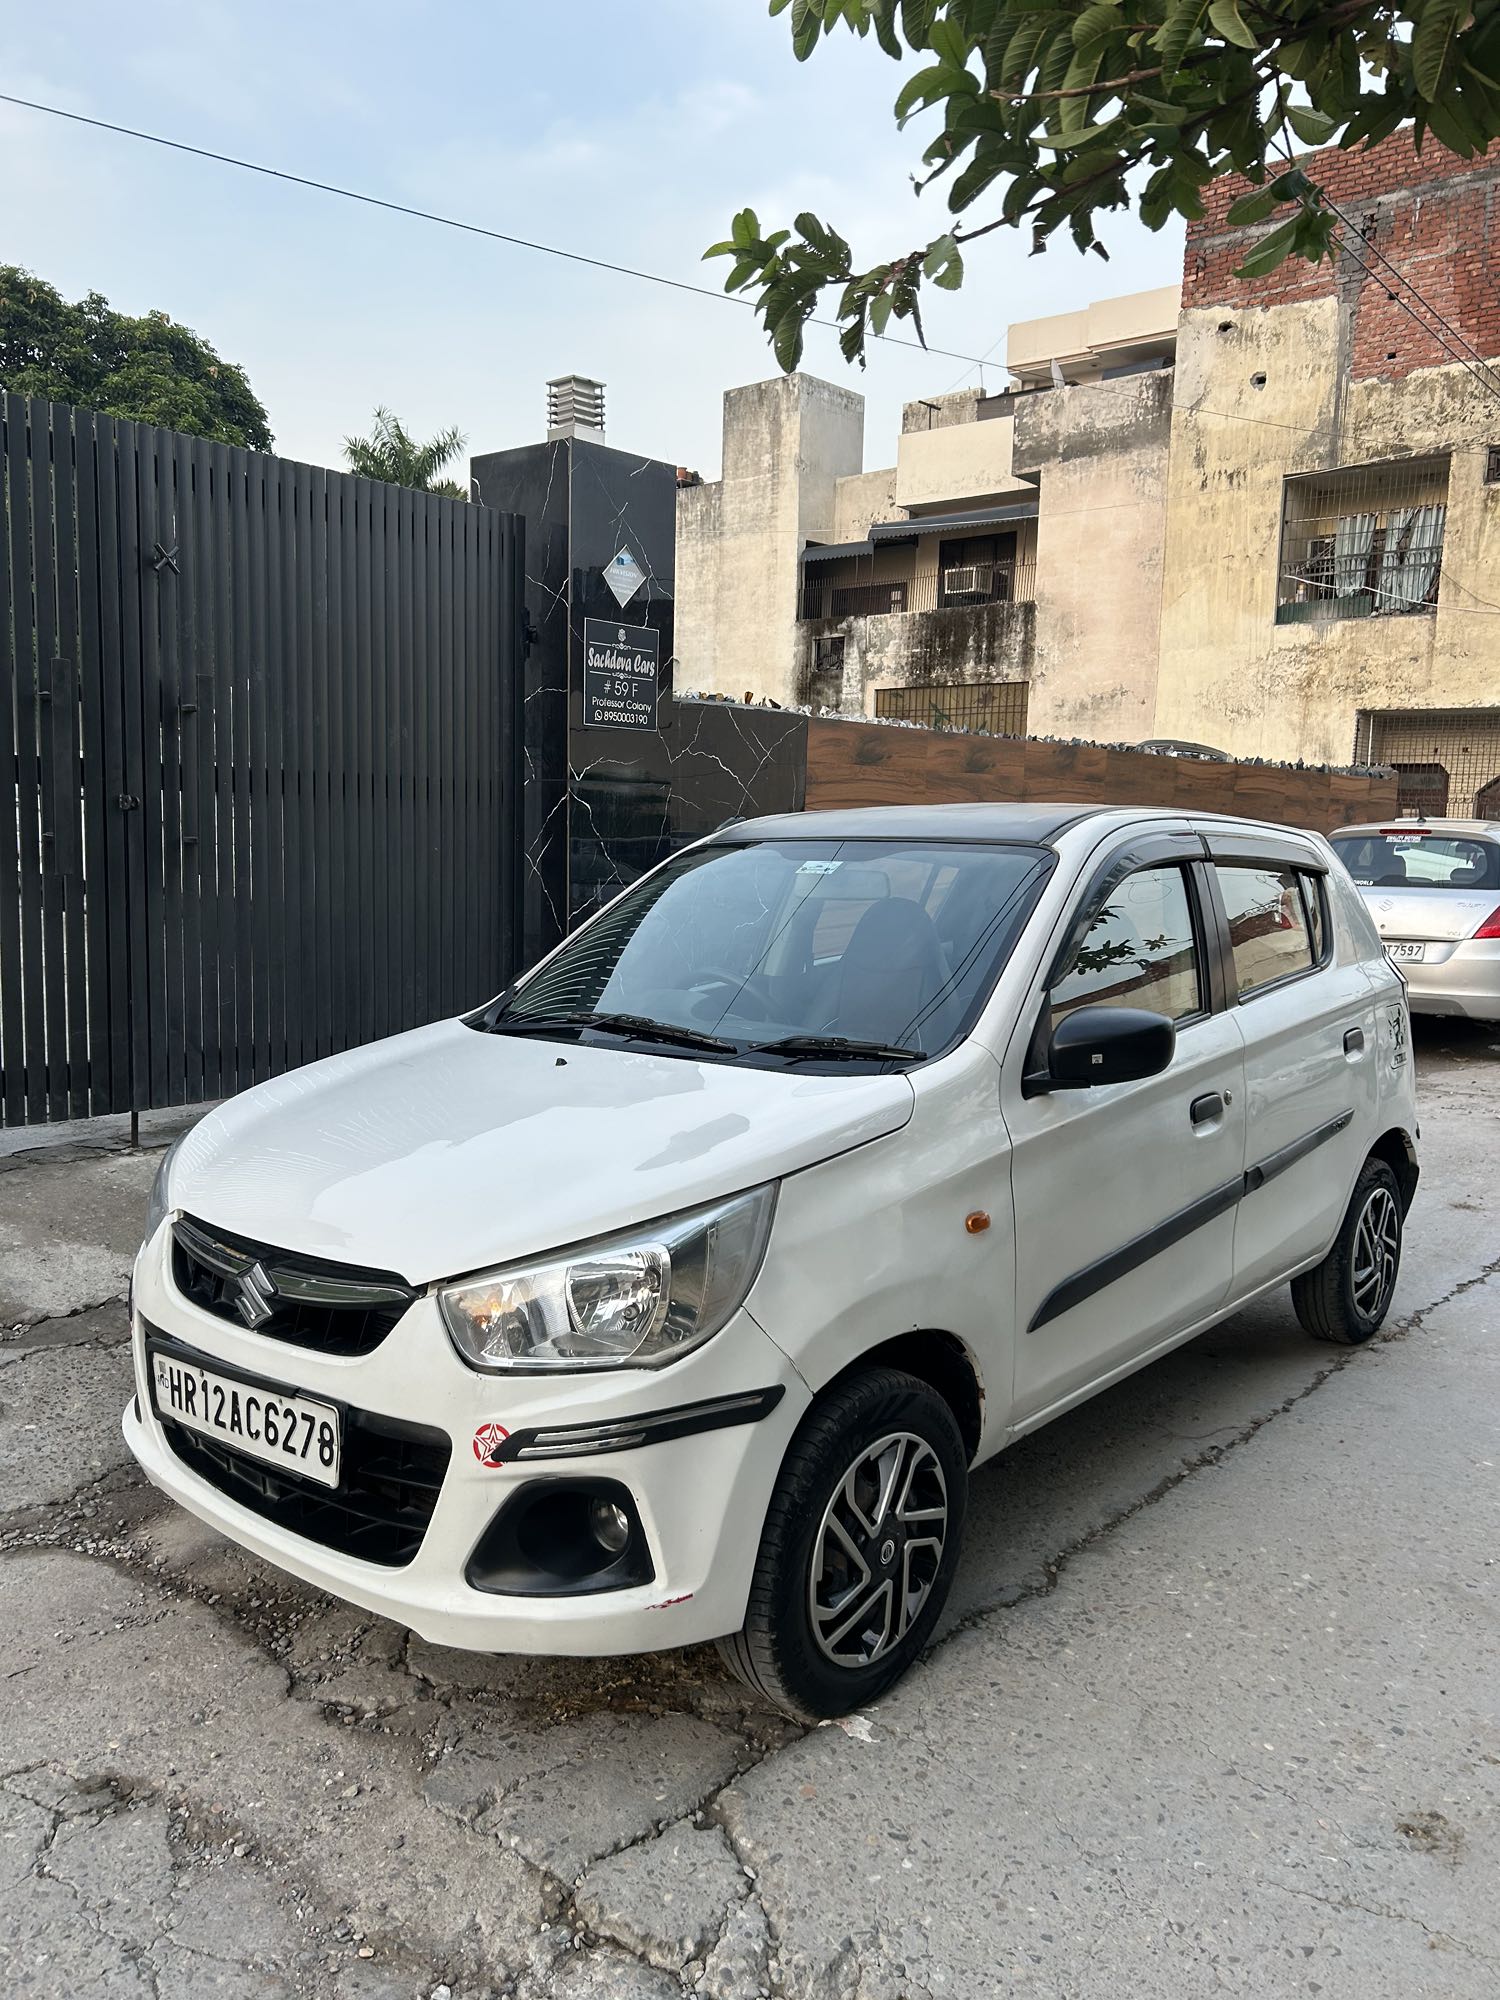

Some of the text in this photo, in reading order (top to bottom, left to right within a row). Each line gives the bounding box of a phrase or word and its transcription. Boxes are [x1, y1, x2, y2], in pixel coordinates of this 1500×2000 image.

[587, 647, 656, 677] Sachdeva Cars
[614, 681, 630, 696] 59
[632, 683, 639, 697] F
[592, 696, 652, 713] Professor Colony
[603, 711, 648, 725] 8950003190
[169, 1366, 334, 1467] HR12AC6278
